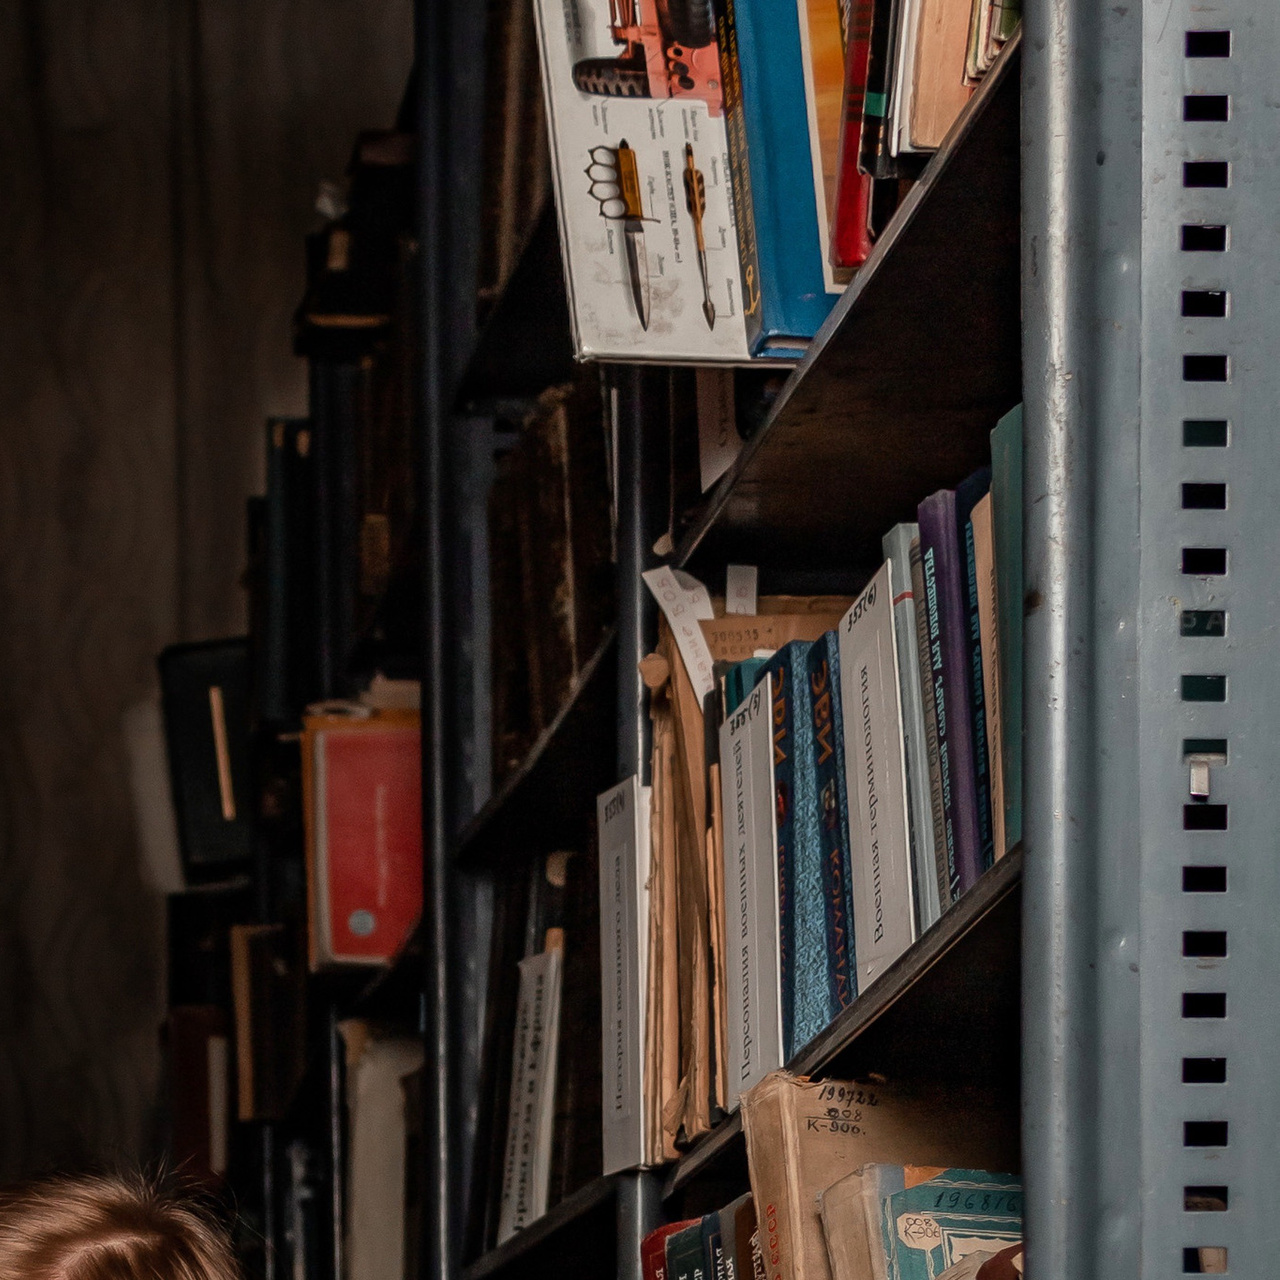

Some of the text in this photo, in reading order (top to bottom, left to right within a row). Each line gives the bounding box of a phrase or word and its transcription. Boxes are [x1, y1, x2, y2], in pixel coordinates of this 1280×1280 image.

[924, 547, 940, 640] ЮНОШЕСТВА
[931, 641, 943, 670] ДЛЯ
[934, 674, 947, 737] СЛОВАРЬ
[859, 665, 884, 945] Военная терминология
[732, 738, 752, 1082] Персоналия военных деятелей
[613, 1019, 625, 1112] История
[764, 1203, 780, 1268] СССР
